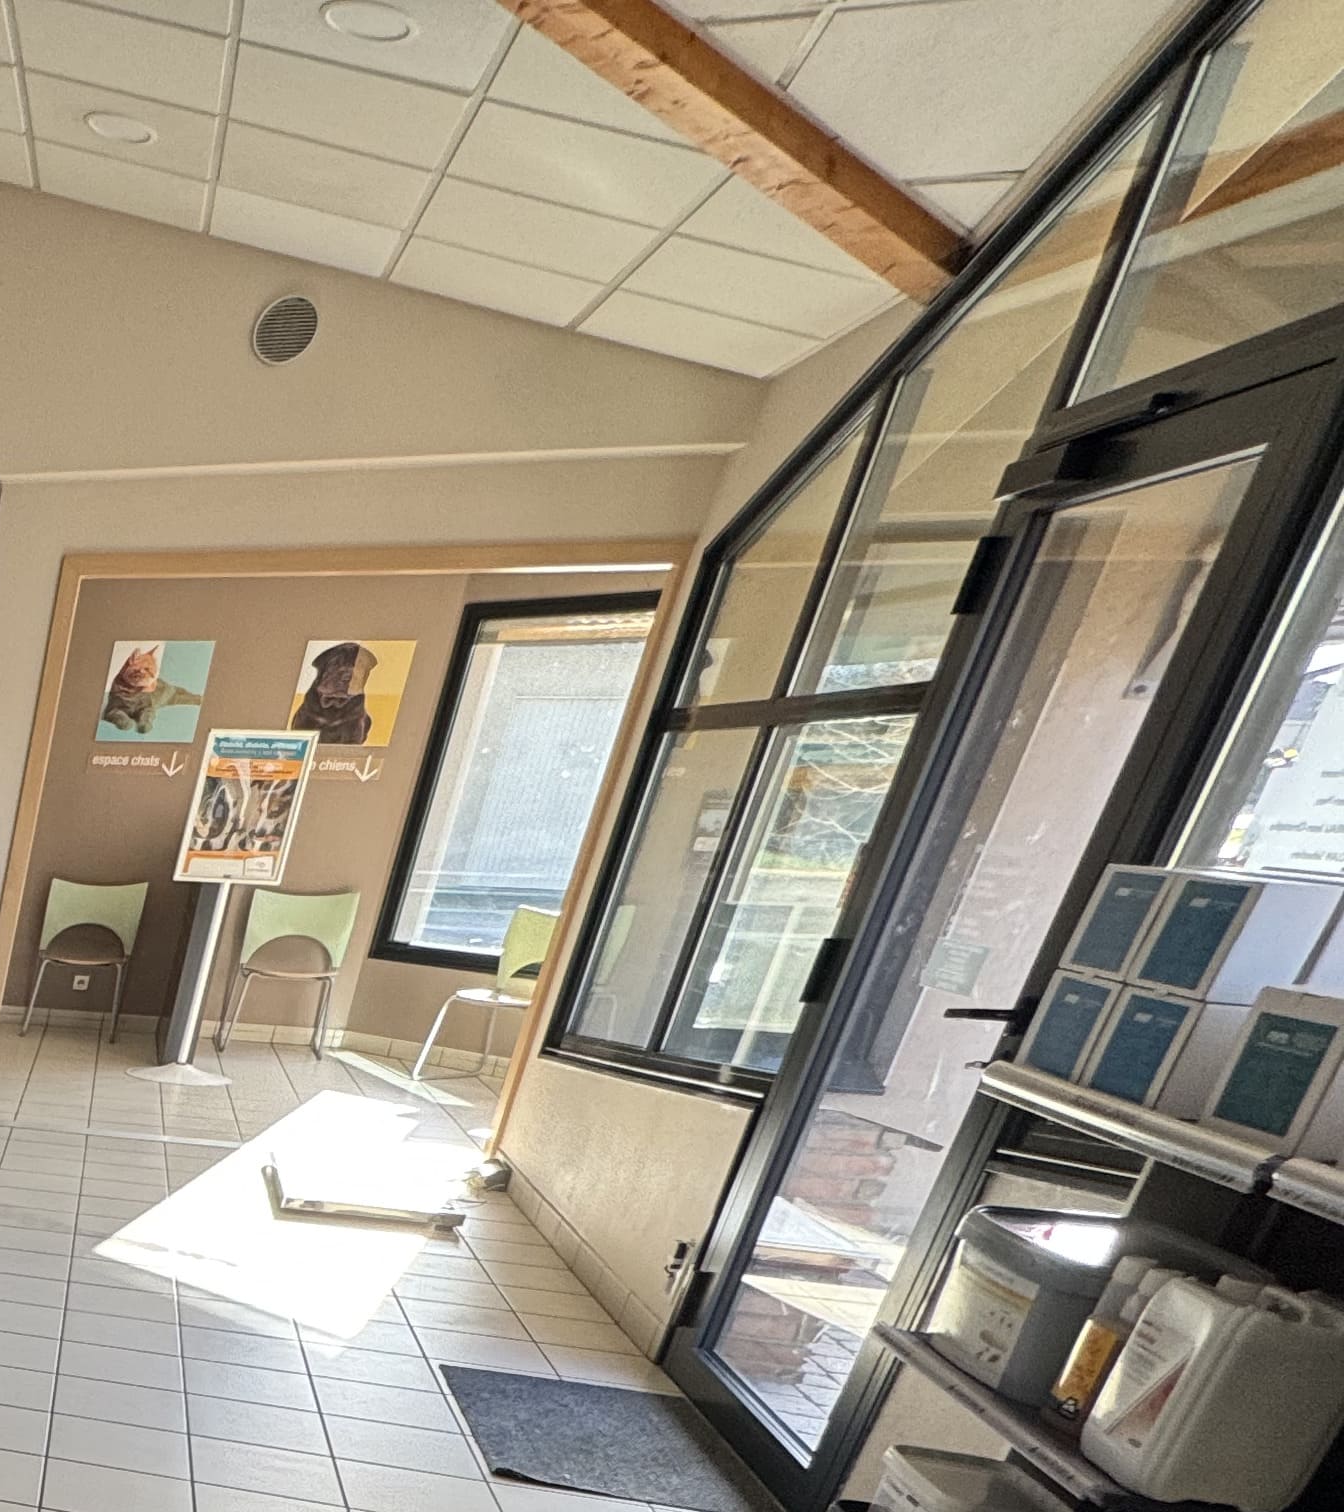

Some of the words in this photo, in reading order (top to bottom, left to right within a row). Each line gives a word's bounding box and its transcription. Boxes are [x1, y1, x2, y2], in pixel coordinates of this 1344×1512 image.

[92, 753, 129, 767] espace
[130, 753, 160, 767] chats
[318, 759, 357, 772] chiens
